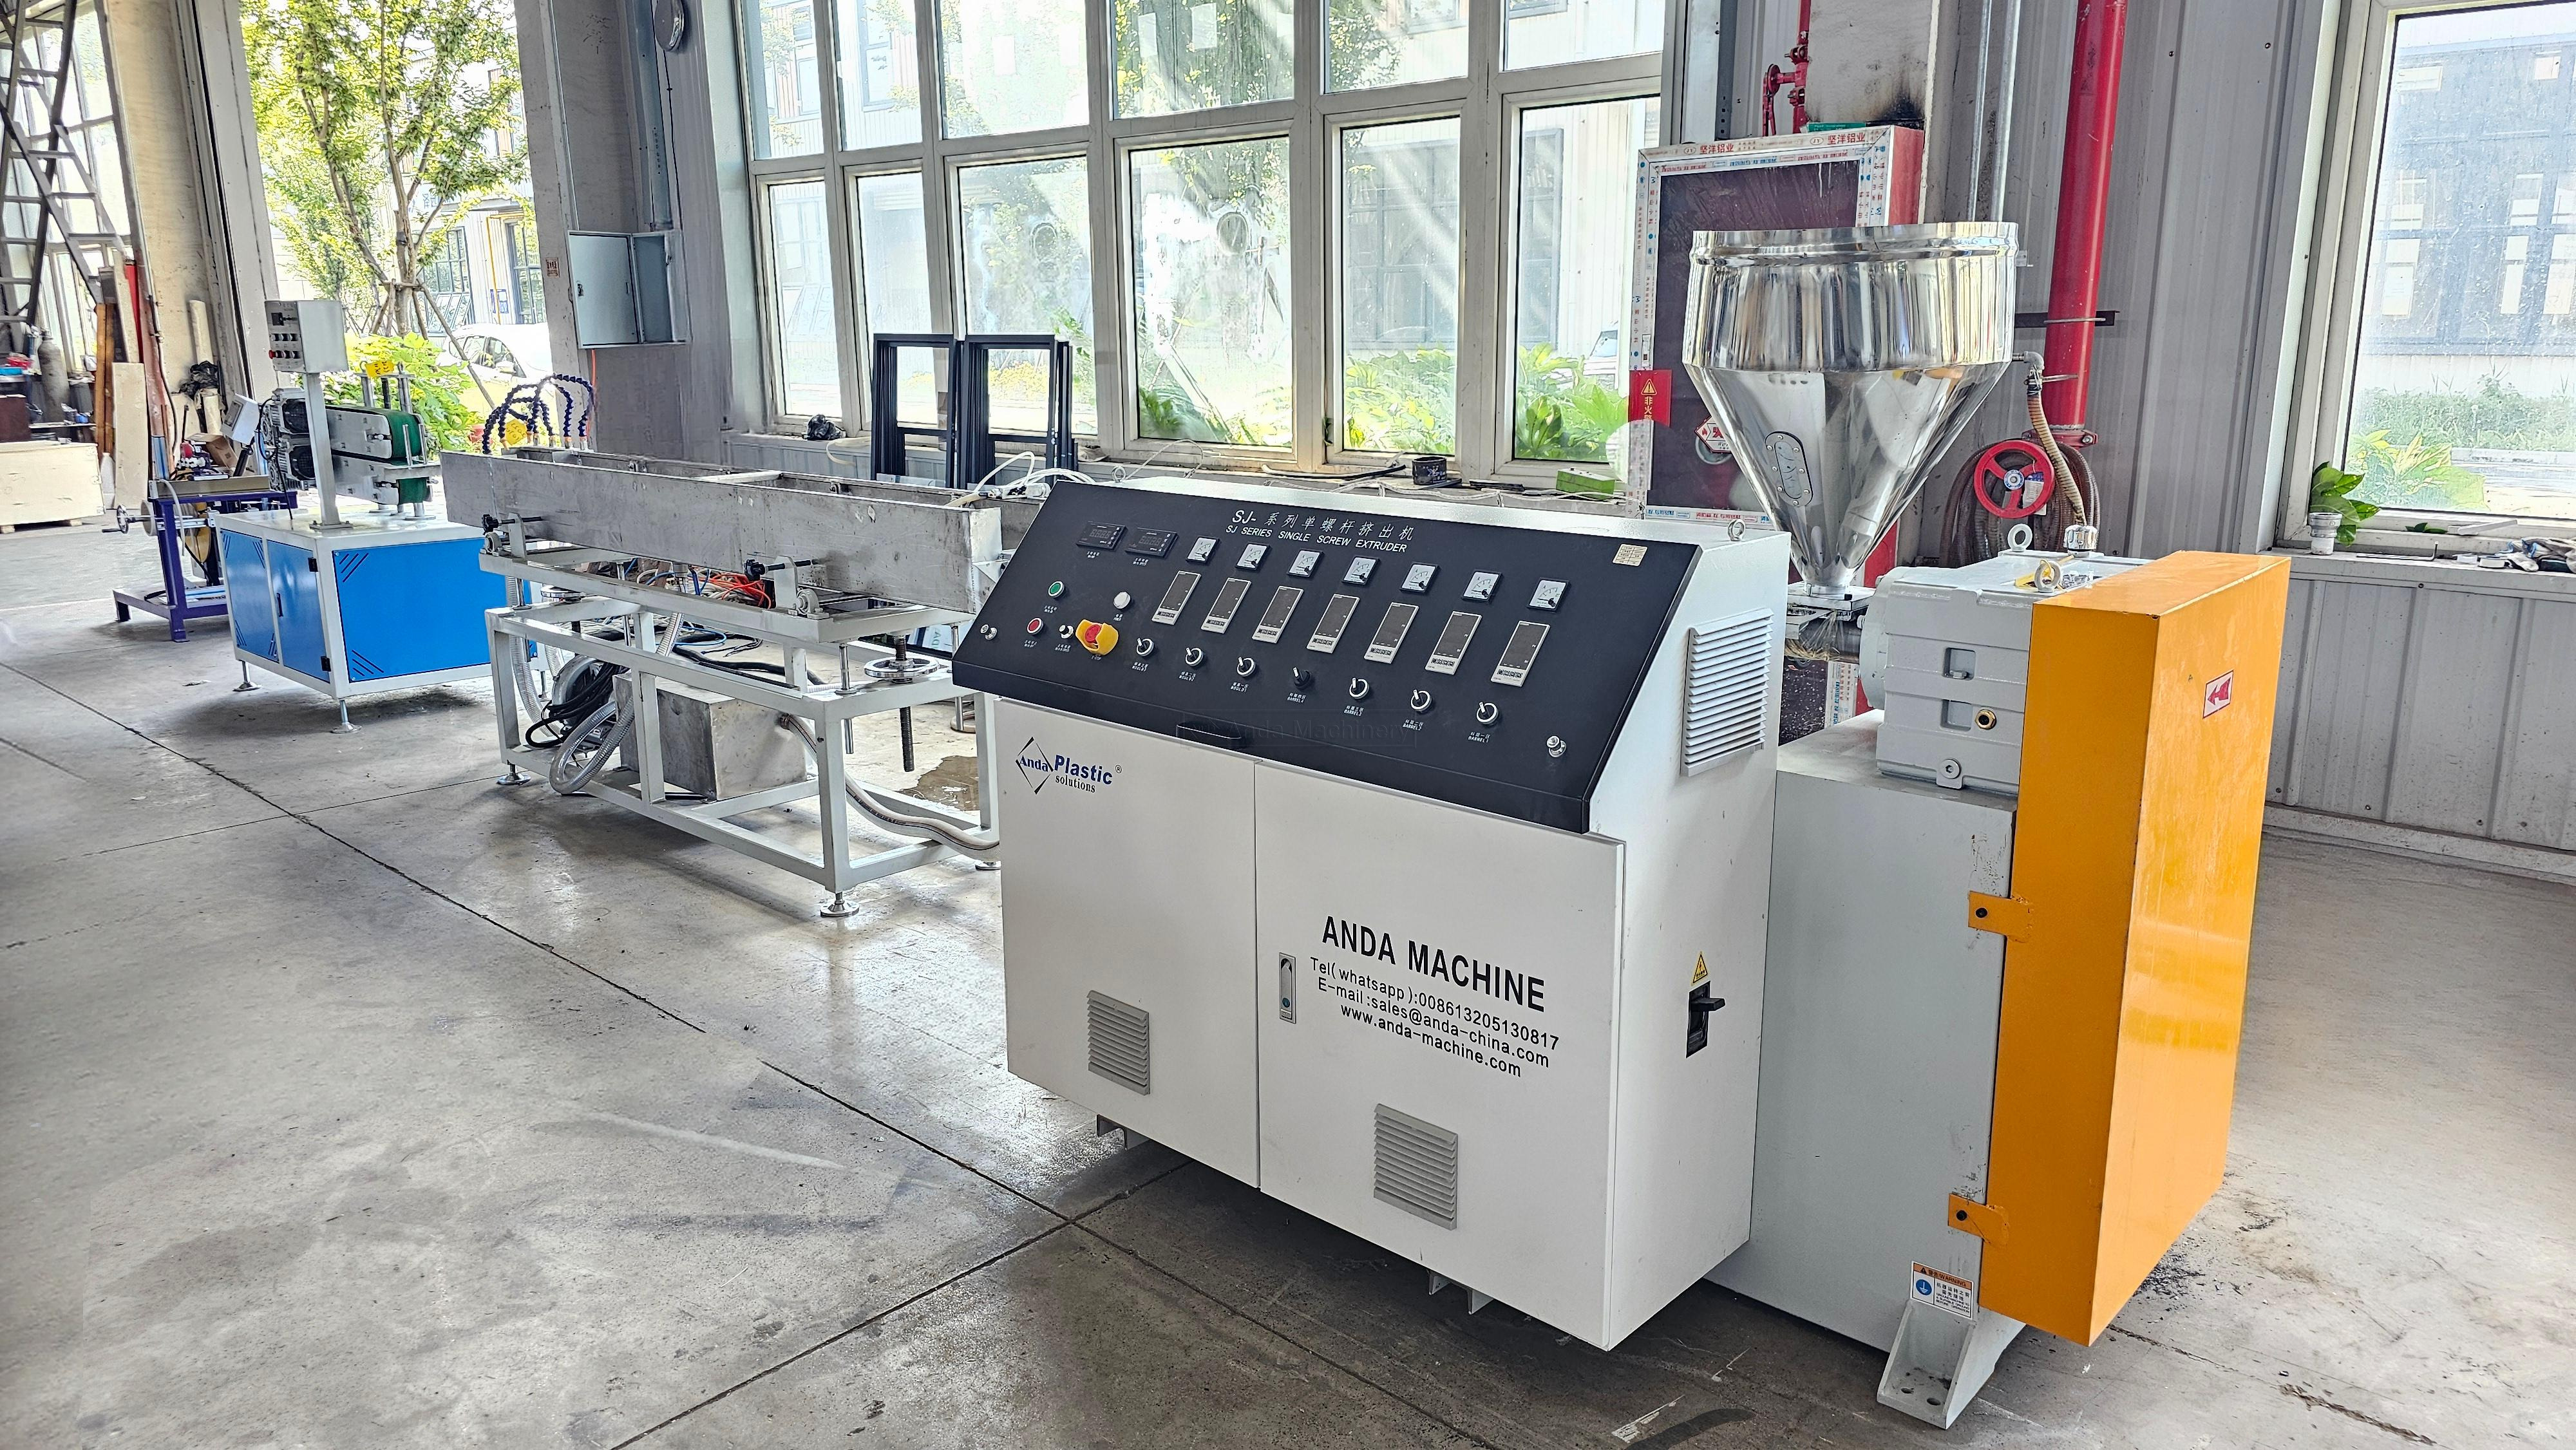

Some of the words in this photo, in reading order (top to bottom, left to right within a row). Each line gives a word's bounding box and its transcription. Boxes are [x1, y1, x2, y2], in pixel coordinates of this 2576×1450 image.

[1700, 143, 1734, 155] 坚洋铝业
[1828, 132, 1866, 145] 坚洋铝业
[1226, 525, 1238, 534] SJ
[1241, 527, 1273, 538] SERIES
[1278, 531, 1311, 542] SINGLE
[1316, 534, 1352, 546] SCREW
[1355, 539, 1408, 552] EXTRUDER
[1264, 511, 1415, 541] 系列单螺杆挤出机
[1020, 755, 1049, 773] Anda
[1054, 755, 1113, 785] Plastic
[1055, 775, 1095, 793] solutions
[1322, 915, 1396, 965] ANDA
[1408, 939, 1545, 1013] MACHINE
[1341, 1004, 1521, 1078] www.anda-machine.com
